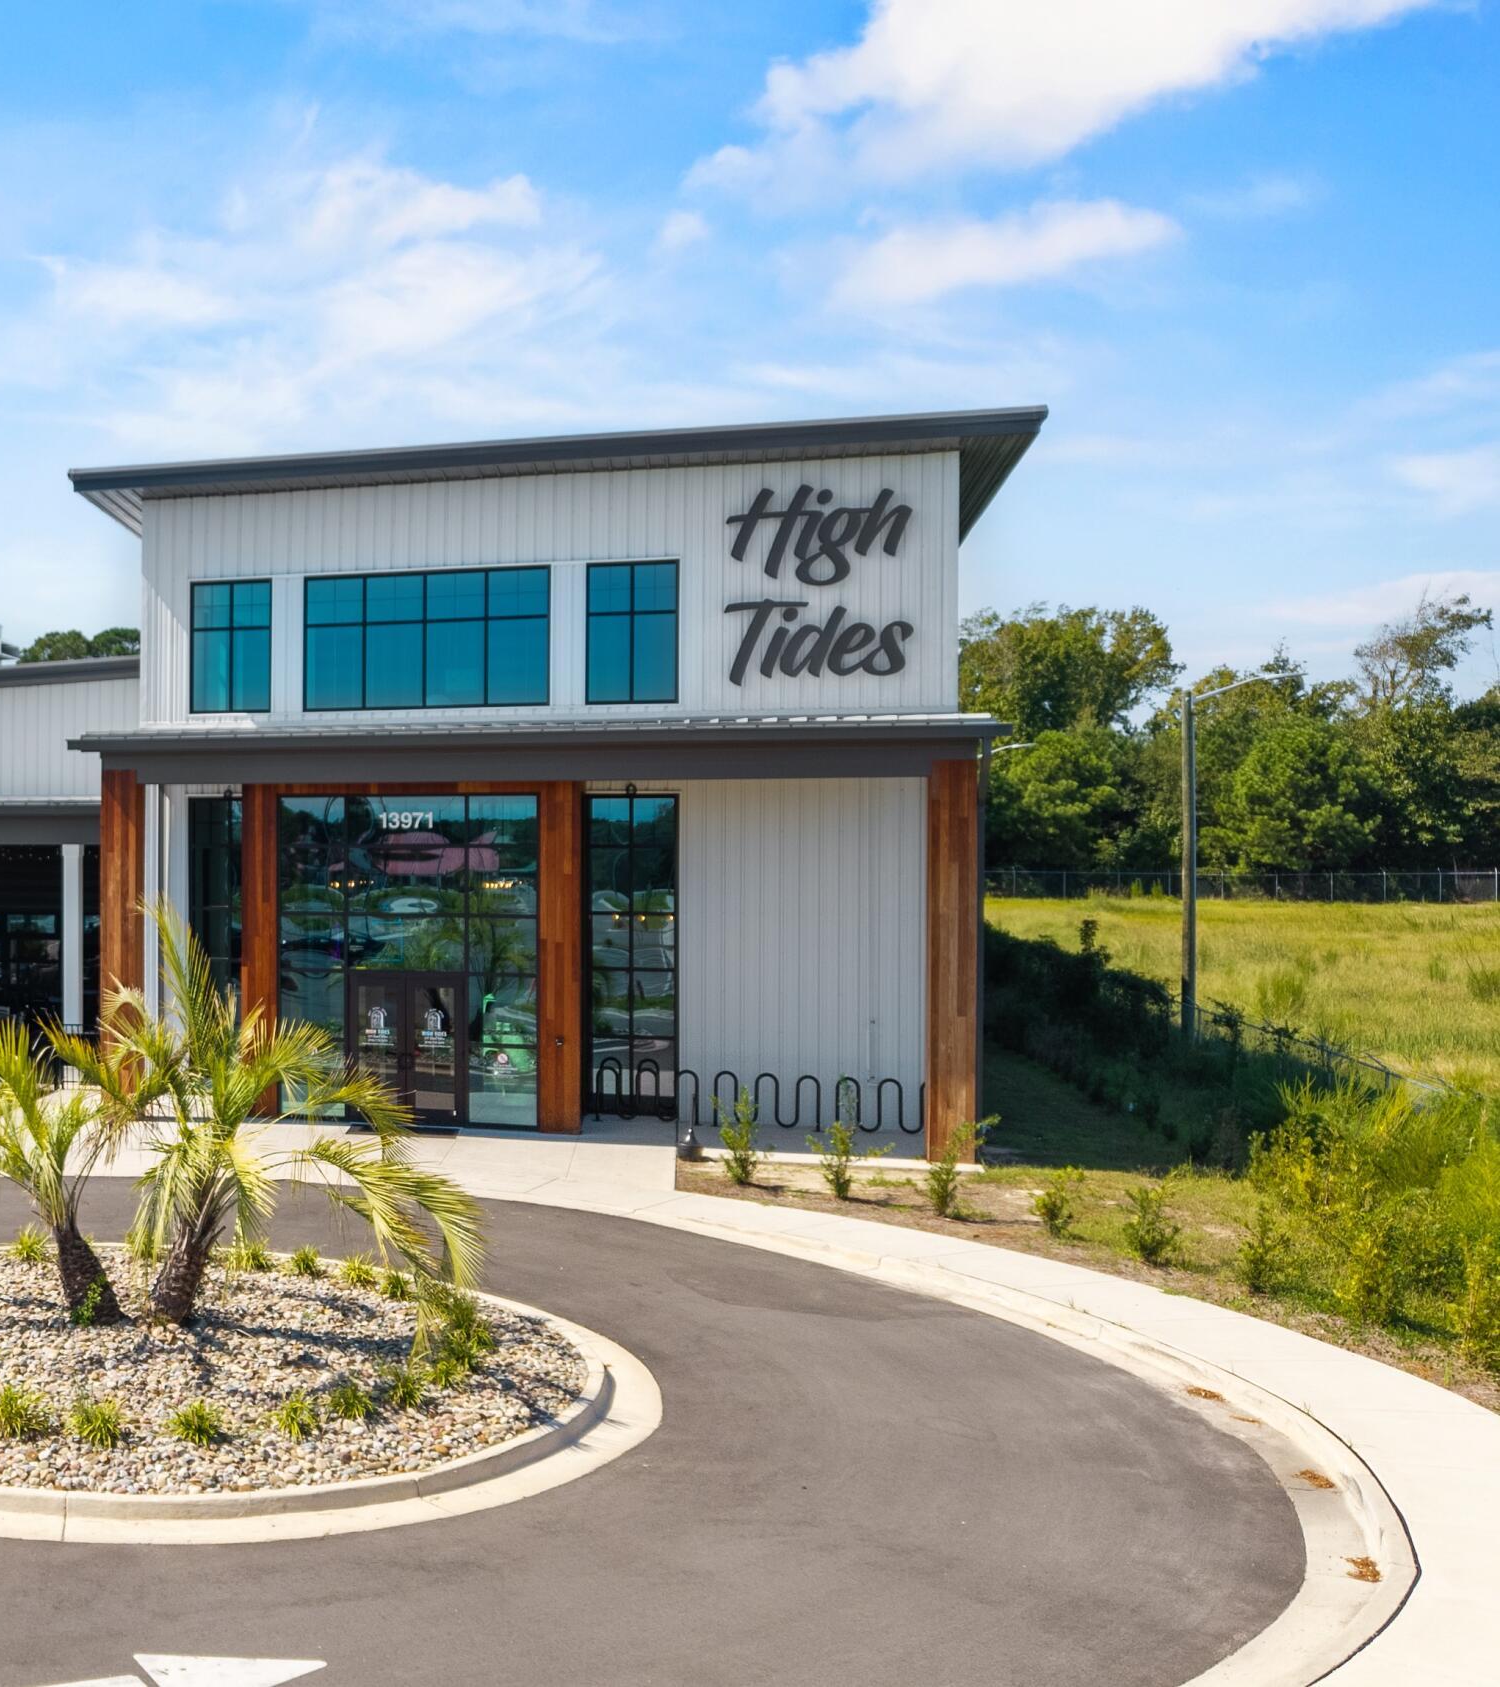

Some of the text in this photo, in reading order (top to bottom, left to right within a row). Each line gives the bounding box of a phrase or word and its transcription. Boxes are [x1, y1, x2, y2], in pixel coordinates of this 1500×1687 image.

[726, 484, 913, 586] High
[724, 598, 914, 686] Tides
[379, 811, 433, 829] 13971
